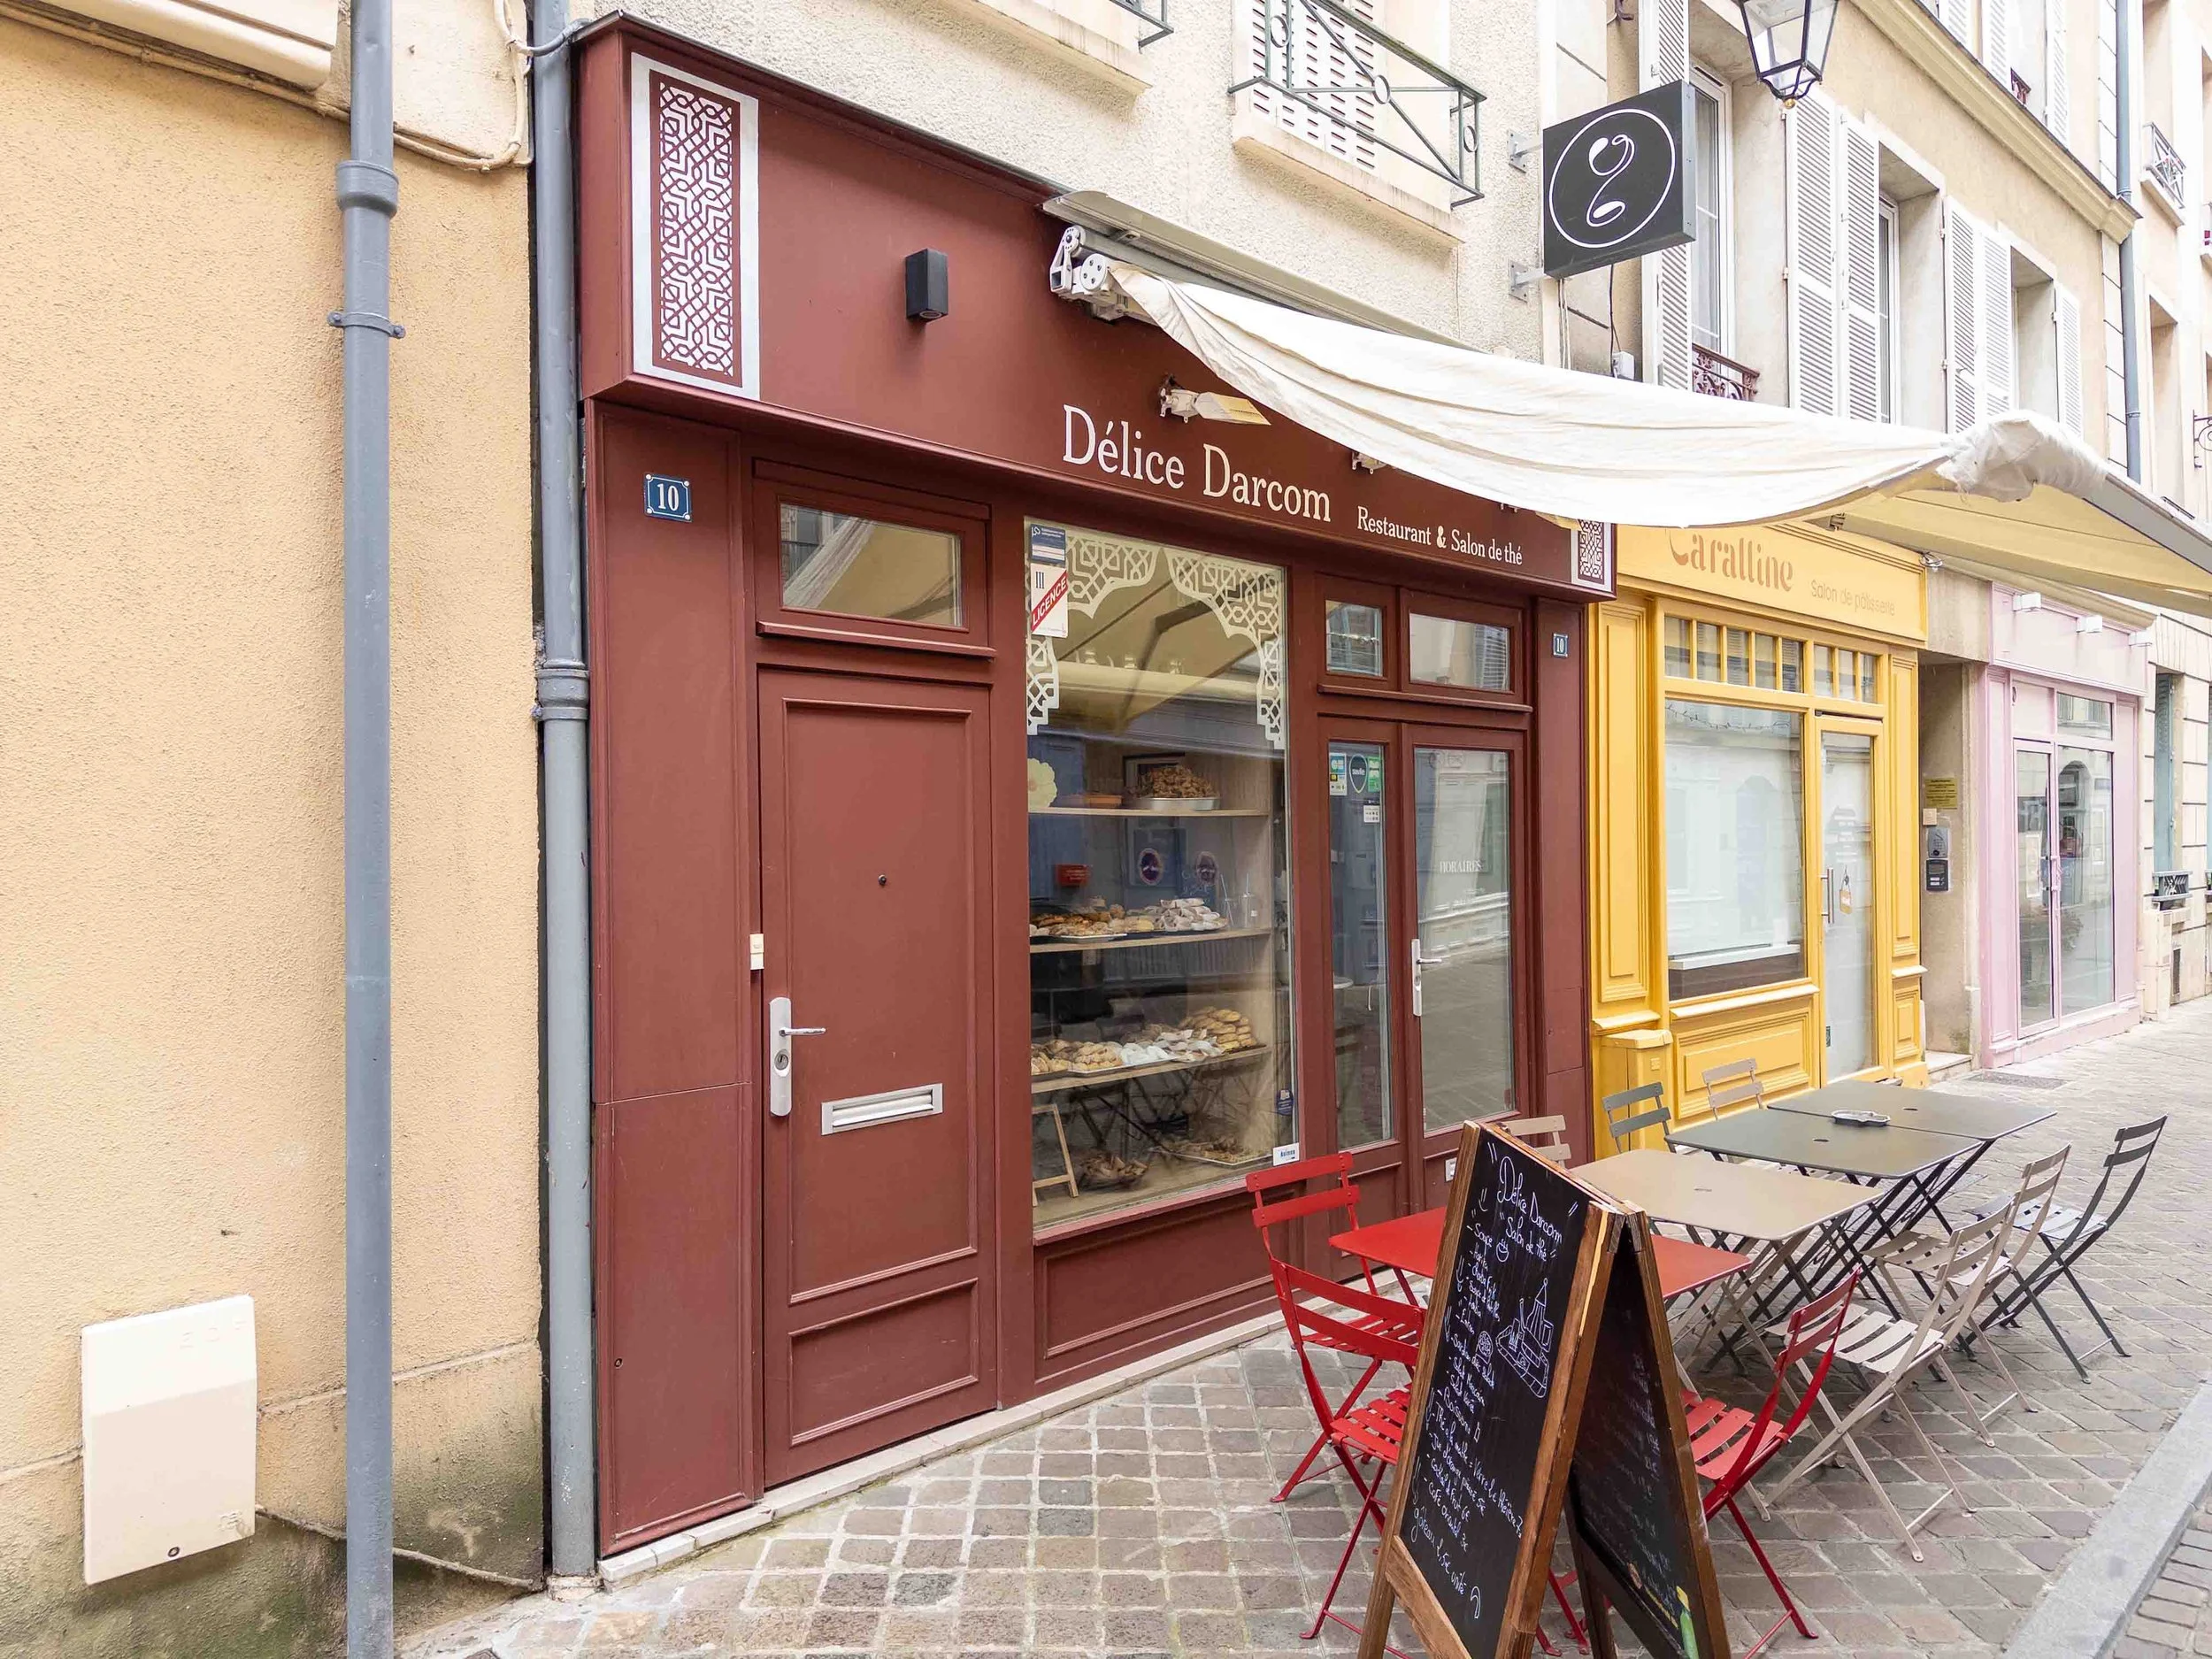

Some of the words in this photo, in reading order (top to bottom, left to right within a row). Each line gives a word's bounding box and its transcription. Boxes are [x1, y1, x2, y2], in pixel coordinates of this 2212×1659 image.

[1062, 403, 1185, 489] Délice
[1202, 443, 1331, 522] Darcom
[657, 483, 680, 511] 10
[1357, 505, 1432, 546] Restaurant
[1436, 525, 1447, 549] &
[1451, 528, 1486, 557] Salon
[1488, 538, 1502, 561] de
[1504, 541, 1523, 565] thé
[1032, 575, 1067, 626] LICENCE
[1810, 579, 1838, 603] Salon
[1840, 588, 1853, 606] de
[1497, 1156, 1526, 1215] Délice
[1530, 1192, 1562, 1244] Darcom
[1506, 1217, 1524, 1248] Salon
